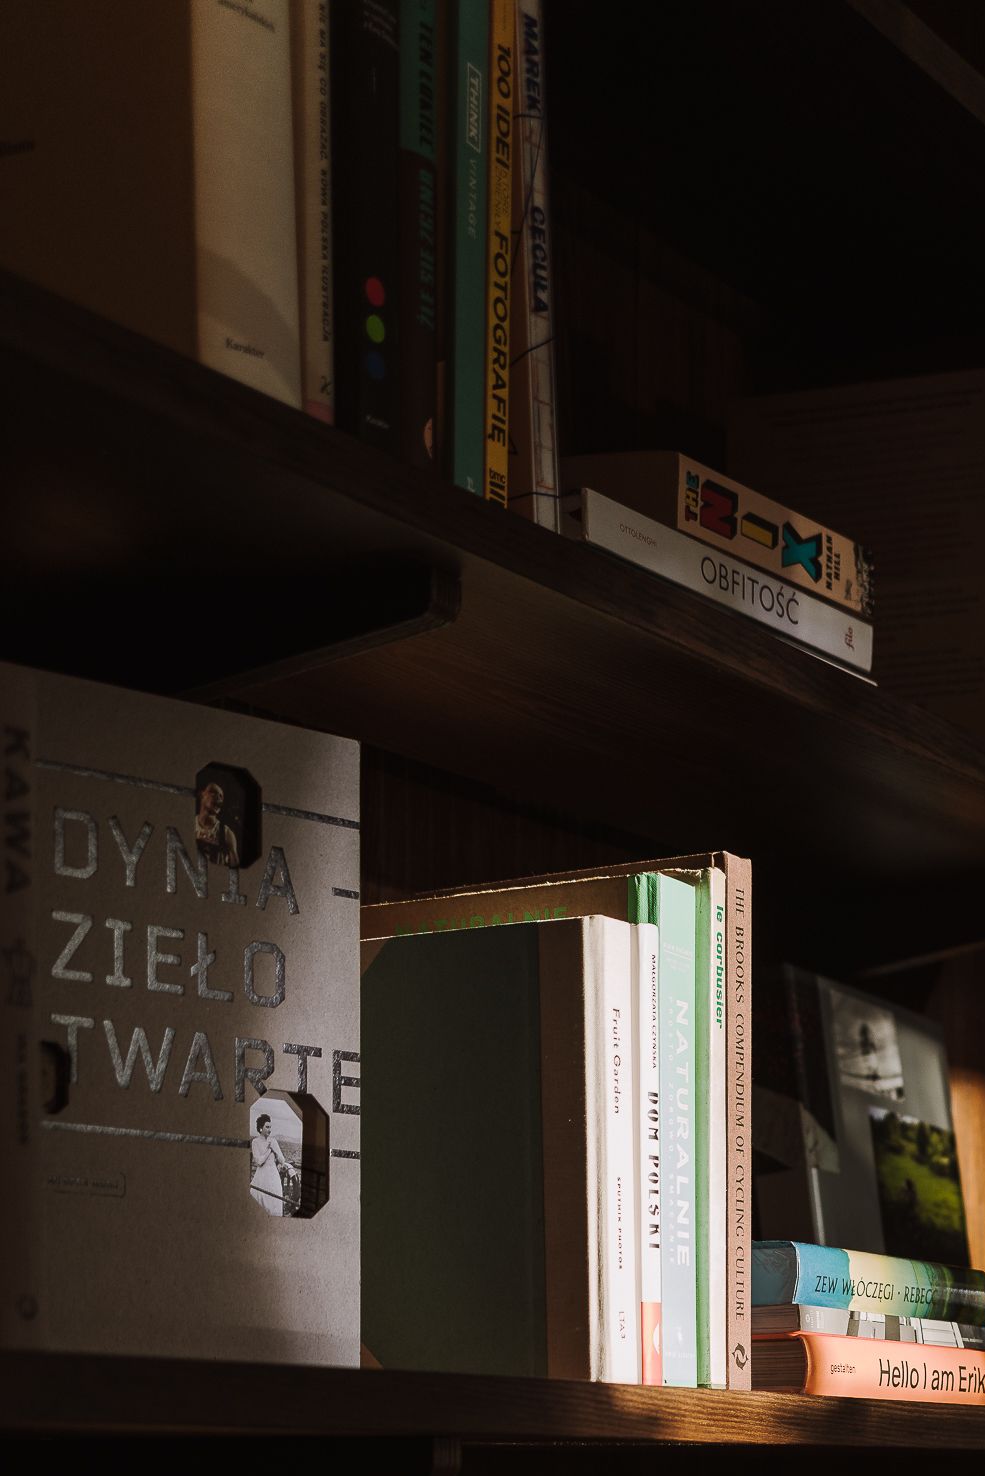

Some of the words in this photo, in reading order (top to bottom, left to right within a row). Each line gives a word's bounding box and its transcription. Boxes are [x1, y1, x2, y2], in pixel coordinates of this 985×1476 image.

[497, 43, 512, 99] 100
[524, 13, 542, 115] MAREK
[468, 71, 481, 143] THINK
[495, 103, 511, 171] IDEI
[468, 158, 481, 240] VINTAGE
[487, 229, 509, 448] FOTOGRAFIĘ
[684, 471, 699, 522] THE
[700, 479, 824, 584] NIX
[701, 556, 799, 625] OBFITOŚĆ
[826, 534, 834, 591] NATHAN
[2, 723, 32, 893] KAWA
[716, 904, 724, 923] le
[734, 887, 745, 920] THE
[51, 908, 286, 1009] ZIEŁO
[715, 930, 724, 1030] corbusier
[734, 926, 745, 1004] BROOKS
[51, 1013, 361, 1115] TWARTE
[612, 1007, 621, 1050] Fruit
[613, 1054, 623, 1114] Garden
[734, 1013, 745, 1128] COMPENDIUM
[675, 999, 689, 1266] NATURALNIE
[734, 1135, 745, 1155] OF
[648, 1154, 660, 1250] POLSKI
[734, 1164, 745, 1238] CYCLING
[734, 1244, 745, 1322] CULTURE
[814, 1275, 838, 1294] ZEW
[842, 1276, 895, 1303] WŁÓCZĘGI
[830, 1361, 857, 1375] gestalten
[878, 1358, 920, 1390] Hello
[923, 1361, 928, 1386] I
[931, 1369, 955, 1392] am
